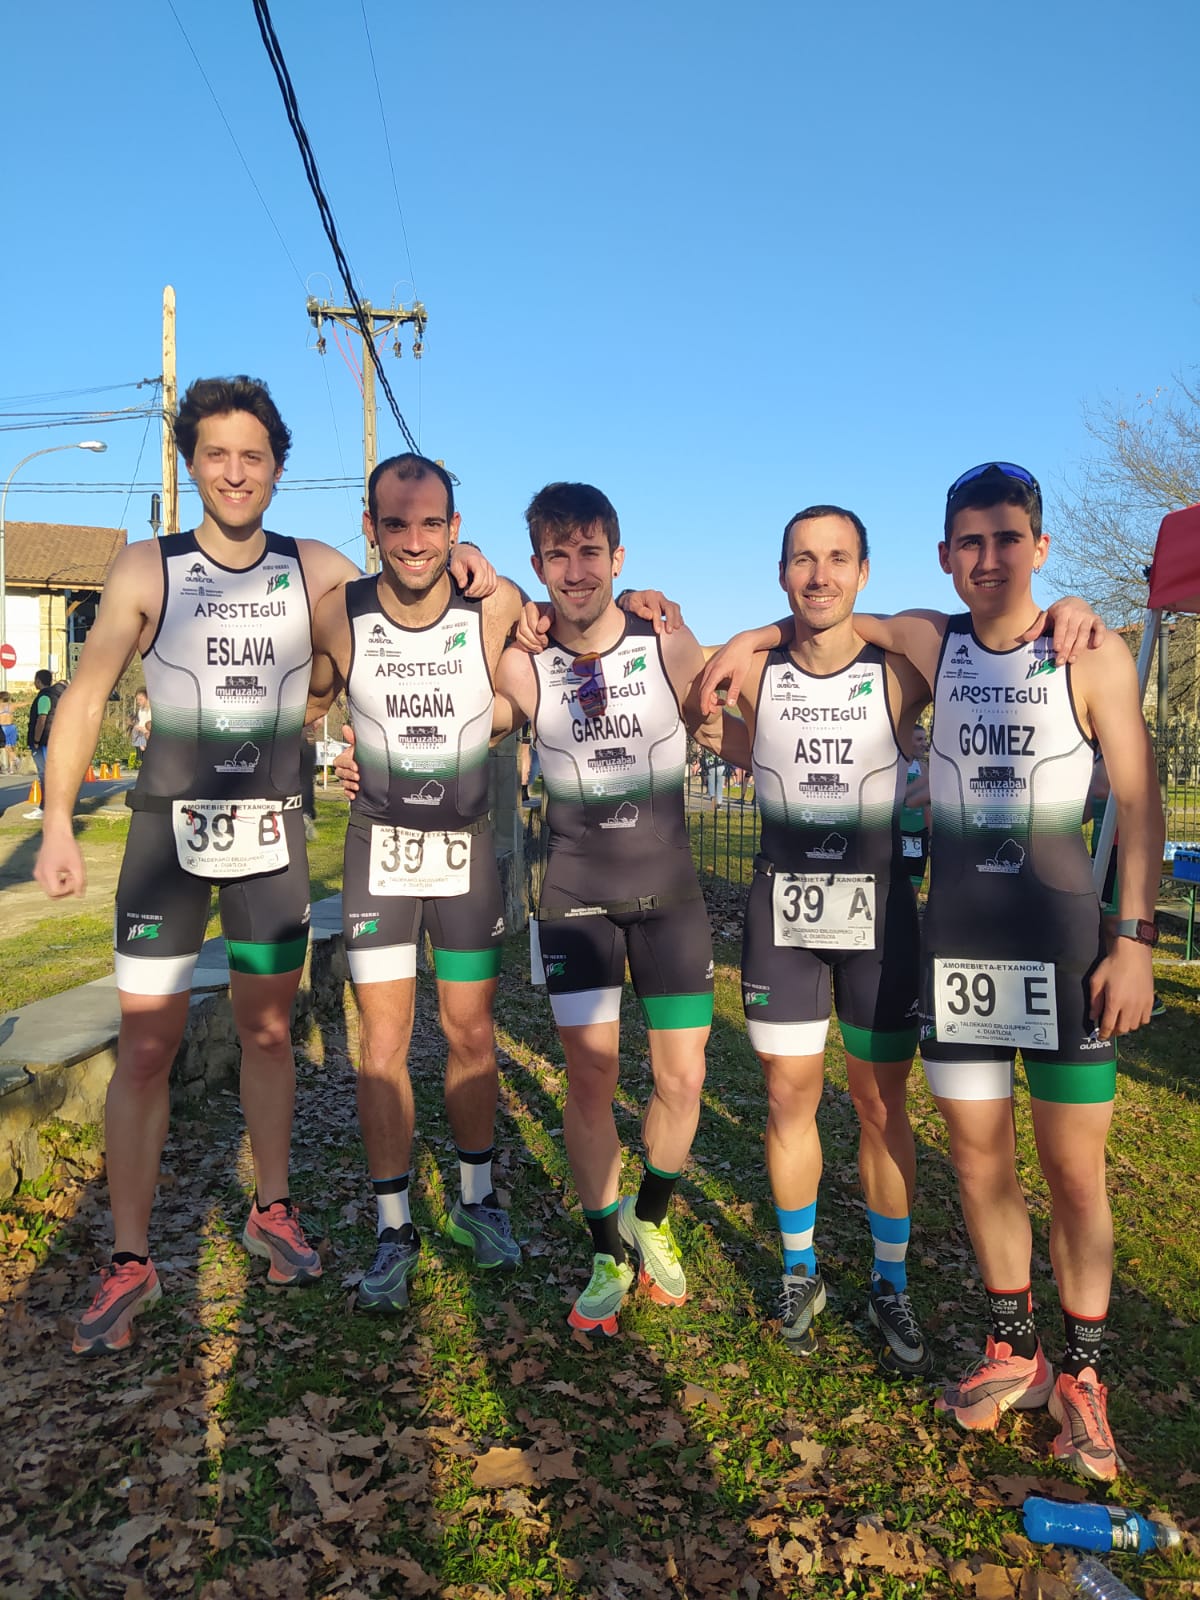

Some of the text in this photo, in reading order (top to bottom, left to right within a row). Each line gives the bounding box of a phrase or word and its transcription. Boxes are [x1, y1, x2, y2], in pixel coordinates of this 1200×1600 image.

[206, 636, 276, 666] ESLAVA
[216, 686, 265, 697] muruzabal
[386, 687, 455, 718] MAGAÑA
[399, 735, 446, 744] muruzabal
[572, 713, 643, 743] GARAIOA
[960, 715, 1036, 756] GÓMEZ
[588, 755, 635, 769] muruzabal
[794, 738, 854, 765] ASTIZ
[800, 782, 848, 792] muruzabal
[970, 777, 1025, 789] muruzabal
[186, 813, 281, 853] 39 B
[381, 838, 468, 874] 39 C
[782, 885, 872, 923] 39 A
[942, 962, 1045, 972] AMOREBIETA-ETXANOKO
[946, 972, 1051, 1017] 39 E
